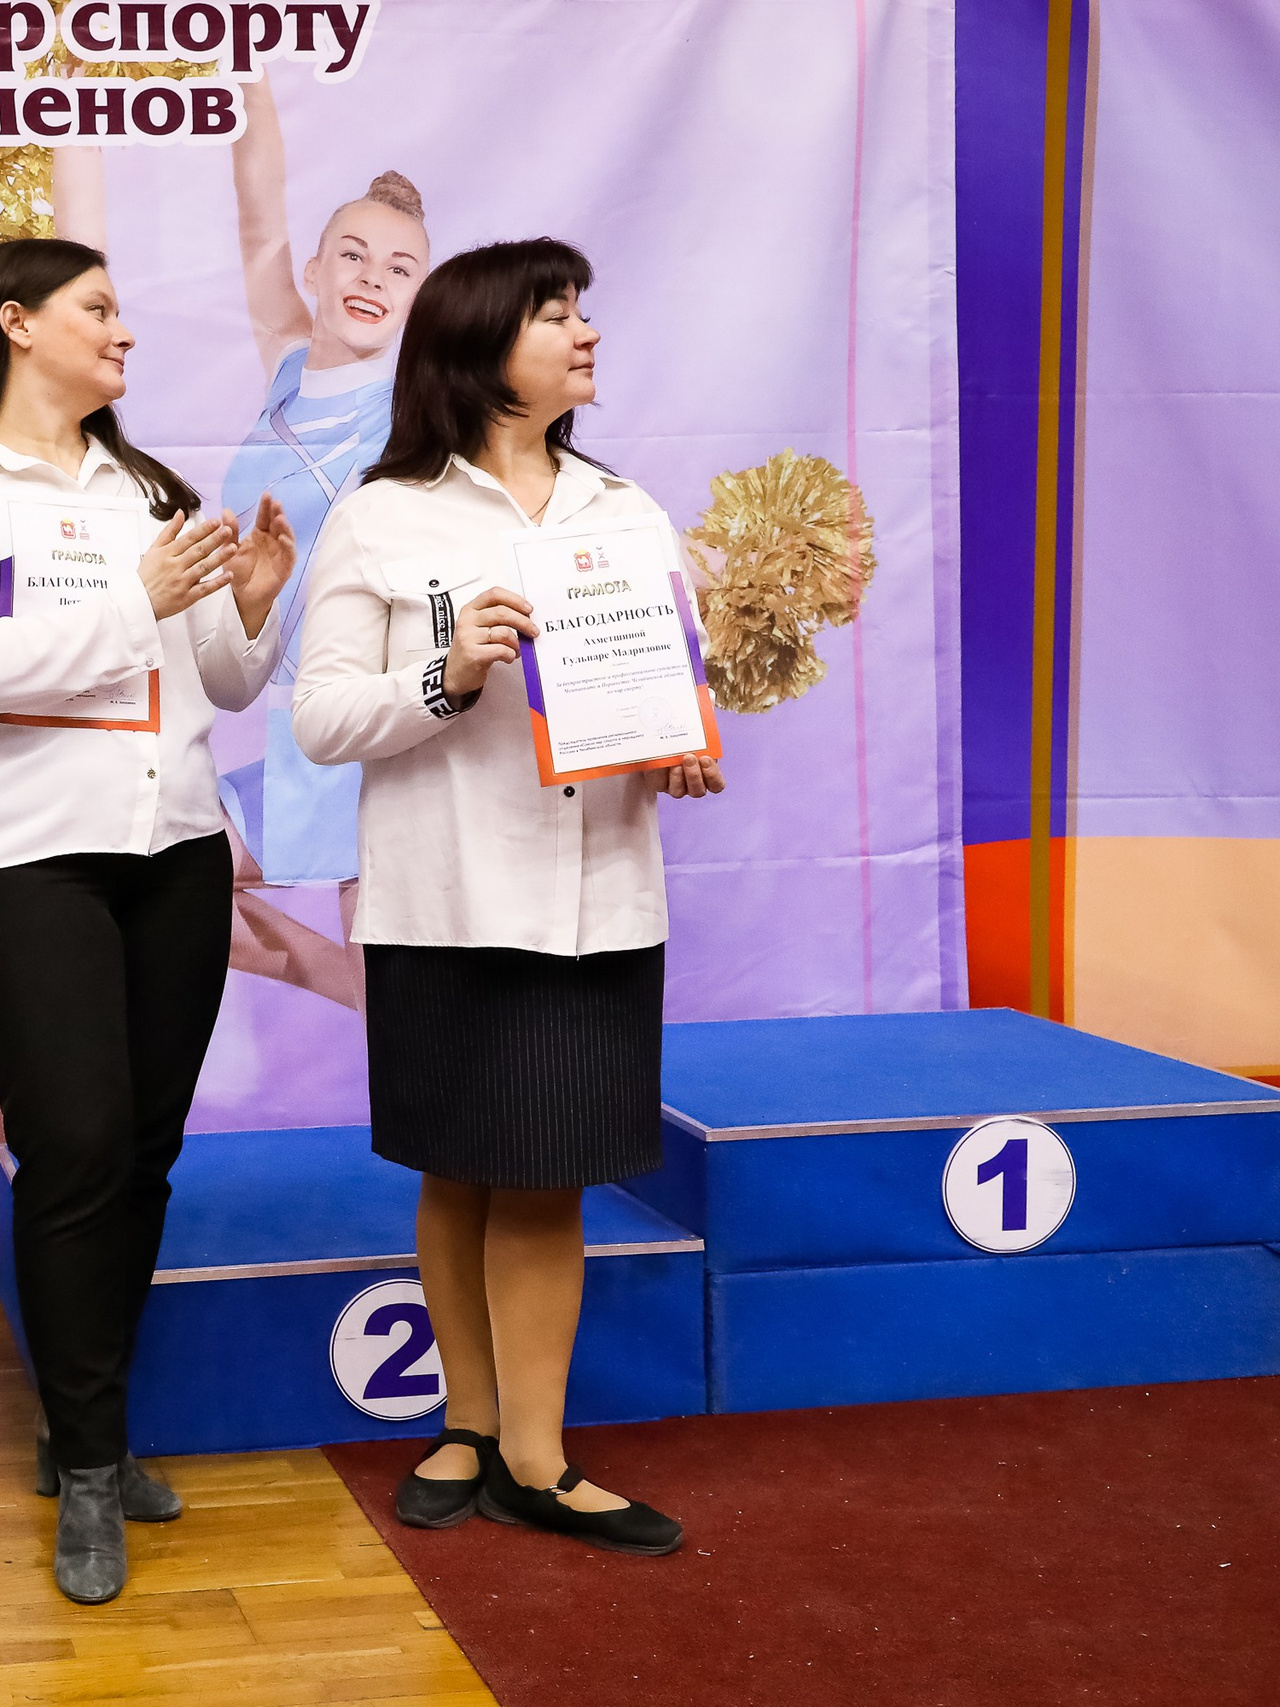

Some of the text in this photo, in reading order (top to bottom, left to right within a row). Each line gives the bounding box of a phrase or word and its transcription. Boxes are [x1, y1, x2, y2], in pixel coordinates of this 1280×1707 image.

[71, 2, 370, 73] спорту
[51, 549, 107, 566] ГРАМОТА
[566, 579, 632, 600] ГРАМОТА
[438, 611, 448, 629] nice
[545, 604, 674, 633] БЛАГОДАРНОСТЬ
[583, 629, 646, 647] Ахметшиной
[976, 1138, 1028, 1232] 1
[362, 1302, 440, 1400] 2
